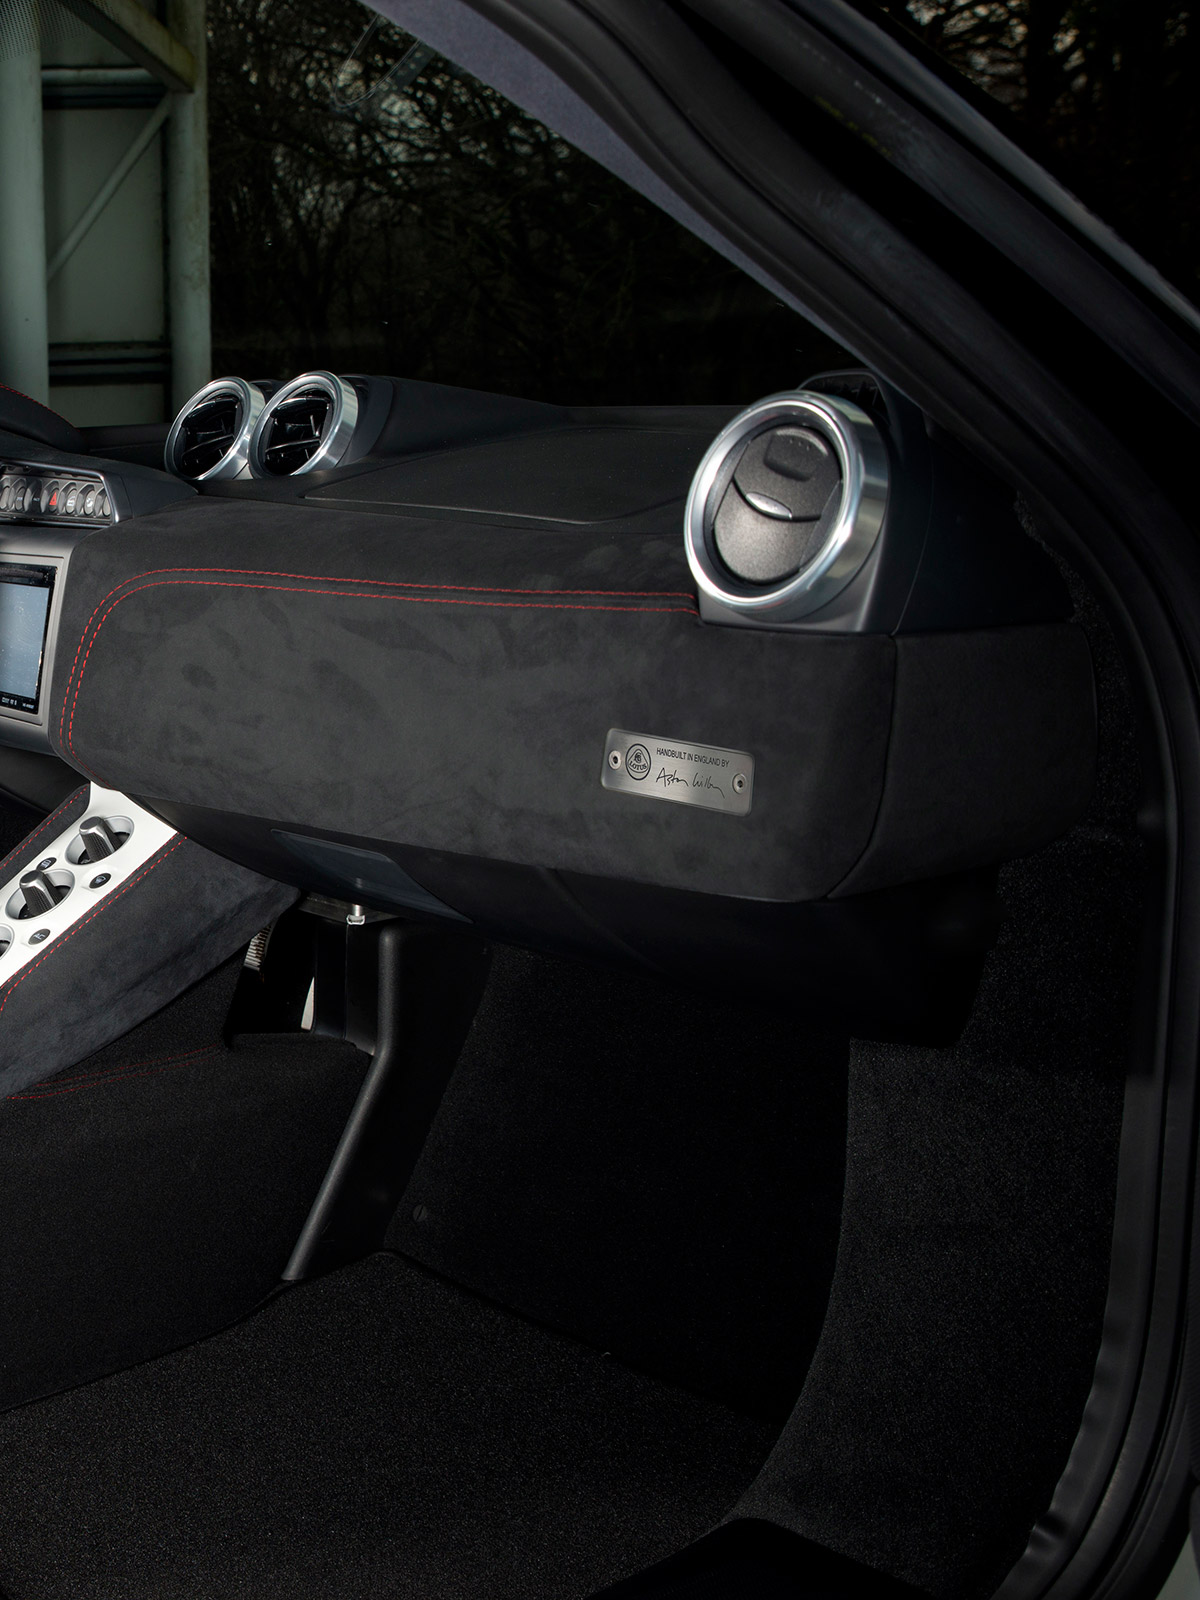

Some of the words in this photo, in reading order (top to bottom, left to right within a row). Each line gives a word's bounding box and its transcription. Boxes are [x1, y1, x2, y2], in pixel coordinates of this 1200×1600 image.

[629, 760, 648, 770] LOTUS
[656, 747, 687, 760] HANDBUILT
[687, 752, 694, 761] IN
[694, 754, 720, 766] ENGLAND
[721, 760, 730, 768] BY
